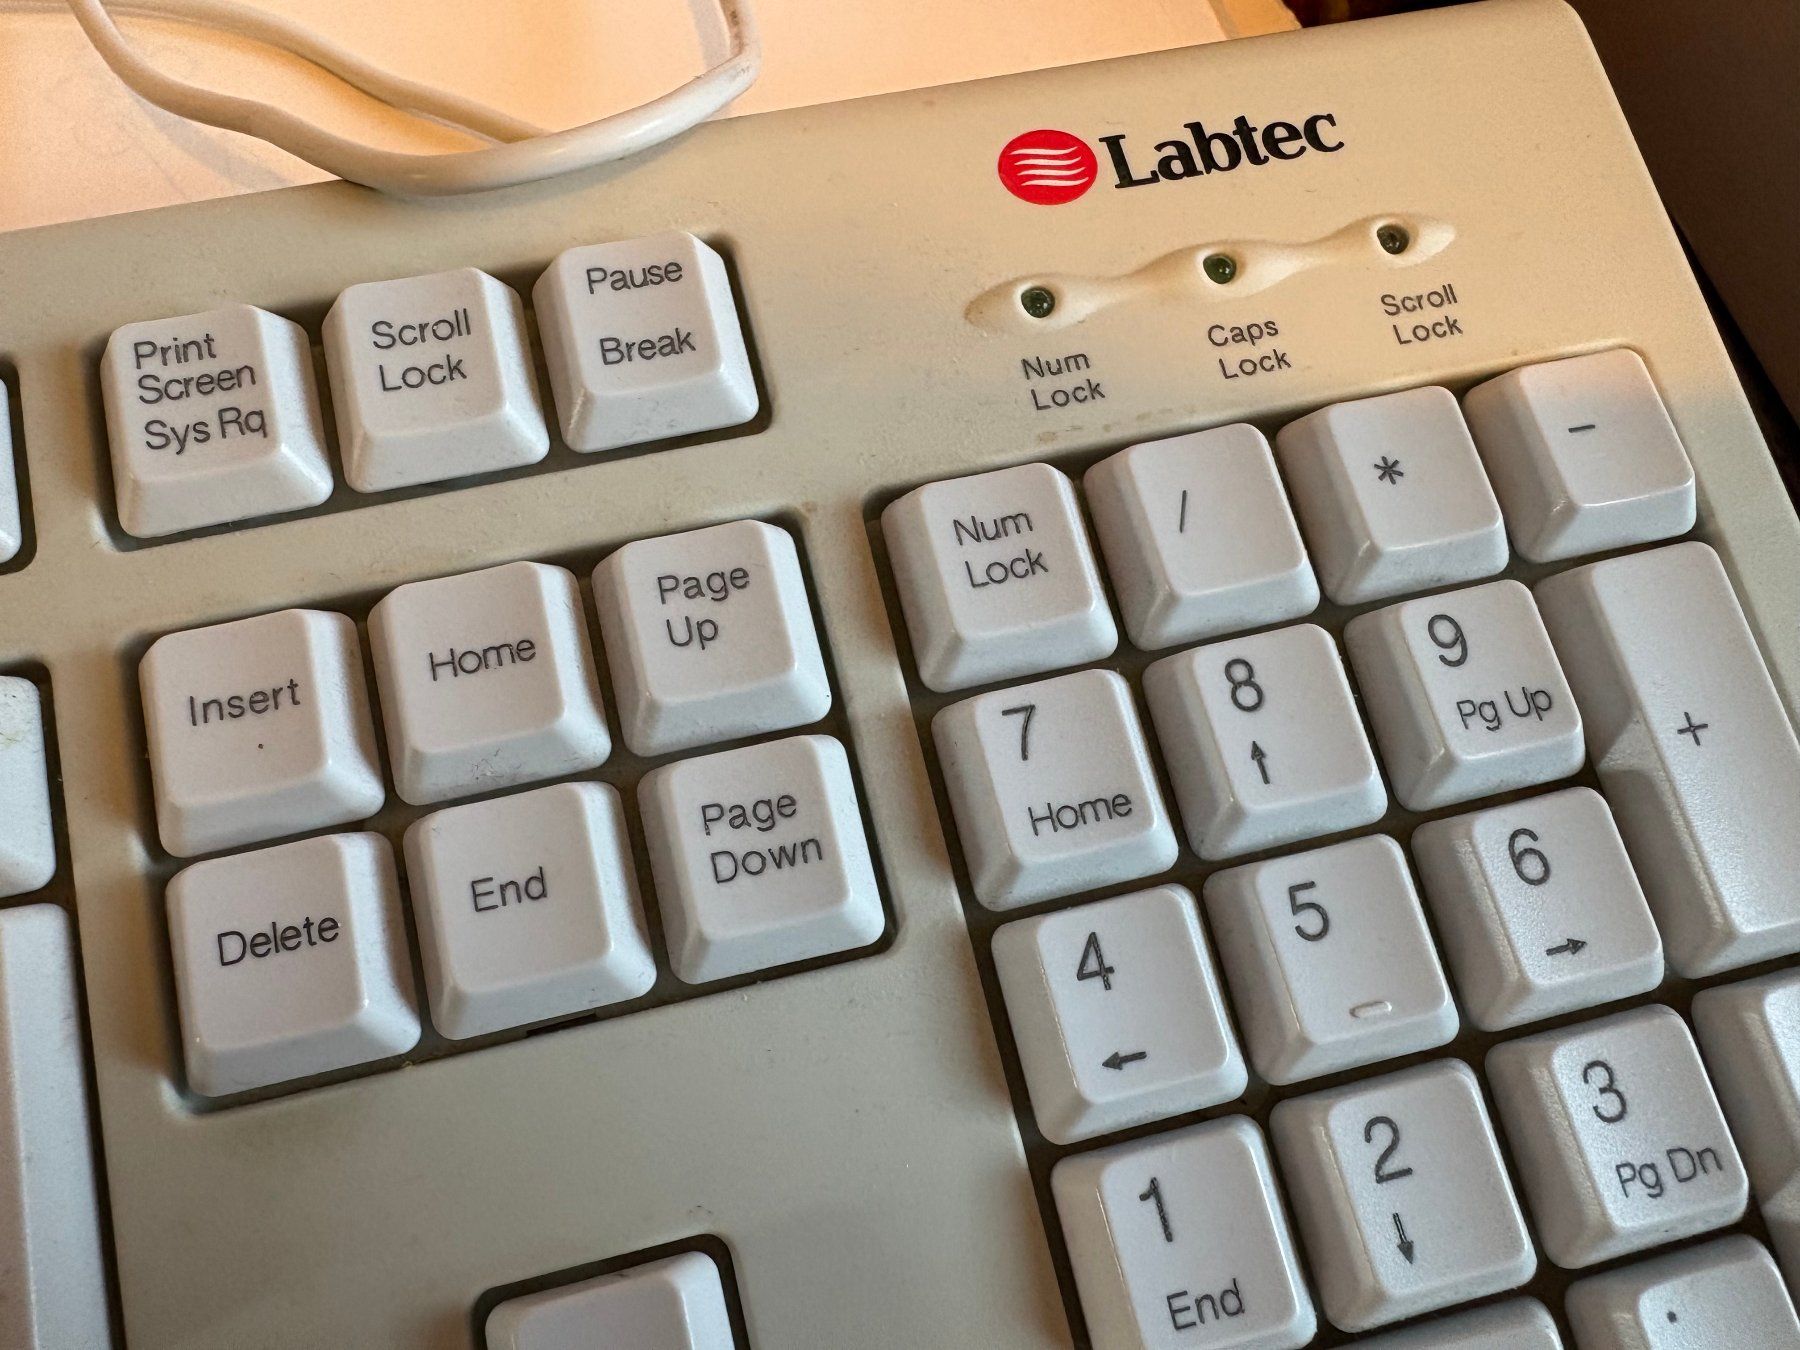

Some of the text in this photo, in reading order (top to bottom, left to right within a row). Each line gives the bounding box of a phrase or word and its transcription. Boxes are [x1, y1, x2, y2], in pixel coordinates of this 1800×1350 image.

[1097, 112, 1346, 190] Labtec
[585, 261, 684, 295] Pause
[1380, 283, 1458, 317] Scroll
[133, 332, 215, 370] Print
[371, 307, 472, 351] Scroll
[598, 327, 697, 366] Break
[1207, 320, 1280, 348] Caps
[1392, 315, 1464, 346] Lock
[137, 364, 257, 405] Screen
[378, 353, 468, 393] Lock
[1020, 352, 1092, 381] Num
[1218, 348, 1292, 380] Lock
[1030, 378, 1106, 412] Lock
[143, 406, 270, 456] Sys Rq
[952, 512, 1034, 547] Num
[655, 567, 751, 606] Page
[964, 547, 1049, 590] Lock
[665, 615, 720, 651] Up
[1427, 613, 1469, 668] 9
[428, 638, 537, 682] Home
[187, 678, 301, 727] Insert
[1223, 657, 1266, 714] 8
[1455, 686, 1554, 733] Pg Up
[1001, 703, 1037, 762] 7
[700, 794, 798, 837] Page
[1027, 793, 1133, 838] Home
[709, 837, 824, 885] Down
[1507, 827, 1552, 887] 6
[469, 865, 548, 914] End
[1287, 880, 1331, 943] 5
[216, 916, 340, 967] Delete
[1075, 931, 1116, 992] 4
[1580, 1059, 1629, 1126] 3
[1363, 1115, 1414, 1185] 2
[1614, 1146, 1724, 1200] Pg Dn
[1138, 1176, 1175, 1244] 1
[1165, 1277, 1246, 1333] End
